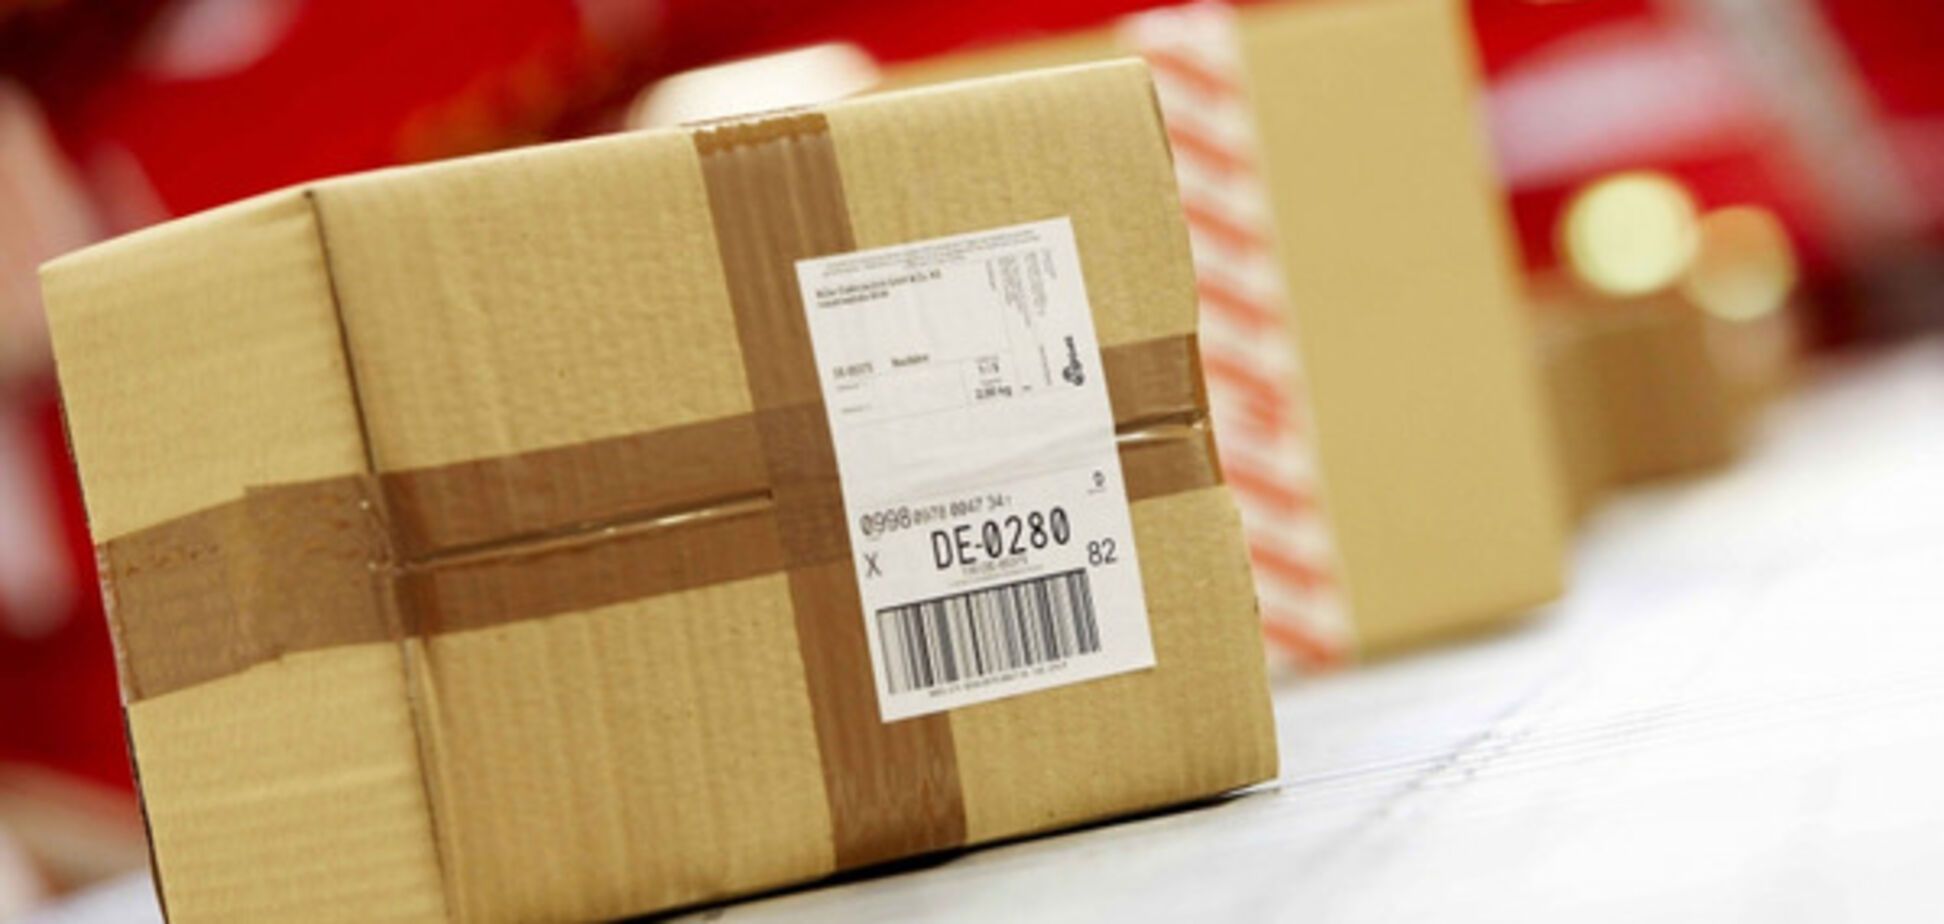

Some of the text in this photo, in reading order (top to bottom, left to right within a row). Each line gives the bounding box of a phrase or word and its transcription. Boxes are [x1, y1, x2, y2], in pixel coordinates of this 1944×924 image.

[859, 505, 912, 537] 0998
[930, 505, 1071, 570] DE-0280
[1087, 537, 1119, 567] 82
[863, 551, 882, 579] X
